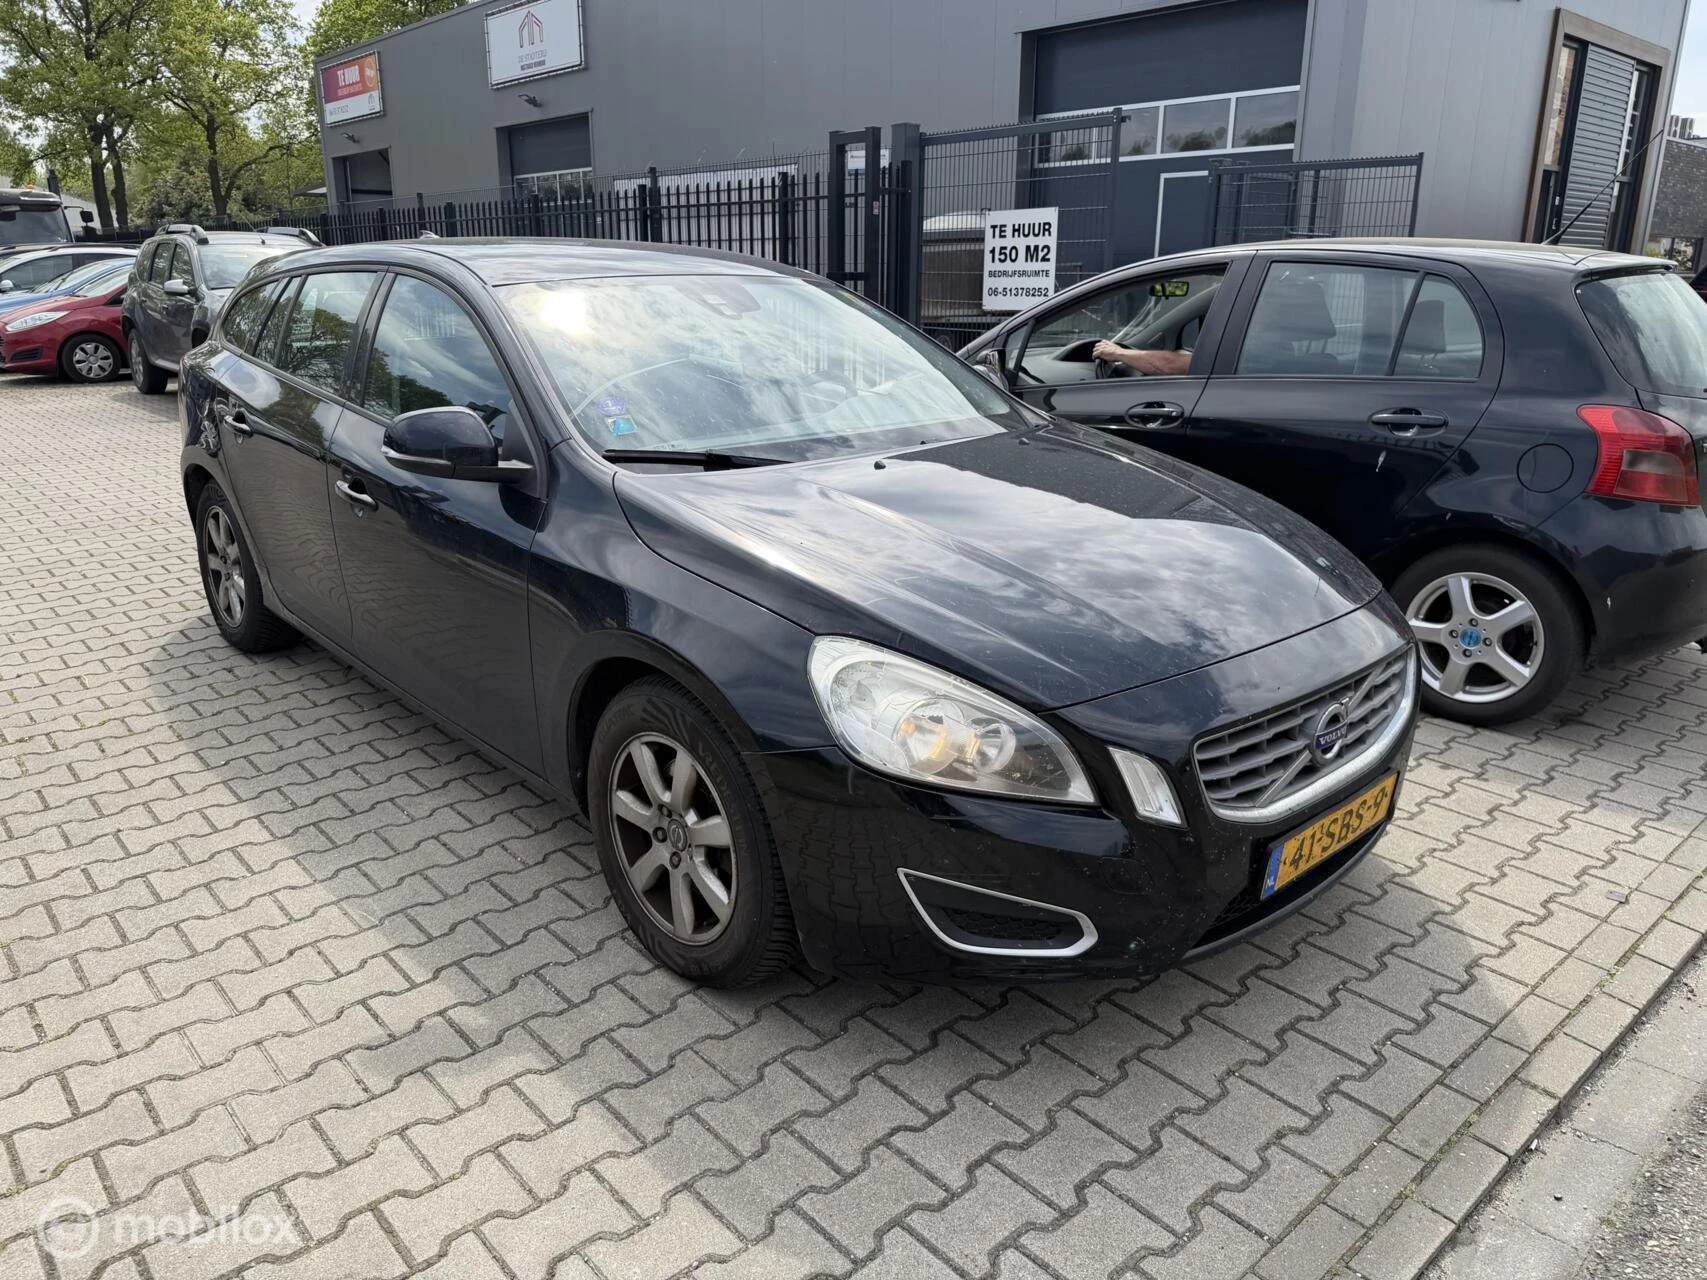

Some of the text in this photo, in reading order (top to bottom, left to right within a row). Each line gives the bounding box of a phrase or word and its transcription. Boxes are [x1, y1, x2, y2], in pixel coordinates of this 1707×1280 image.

[990, 222, 1052, 239] TE HUUR
[989, 245, 1050, 263] 150 M2
[988, 270, 1050, 278] BEDRIJFSRUIMTE
[988, 287, 1049, 297] 06-51378252
[1290, 787, 1386, 870] 41-SBS-9
